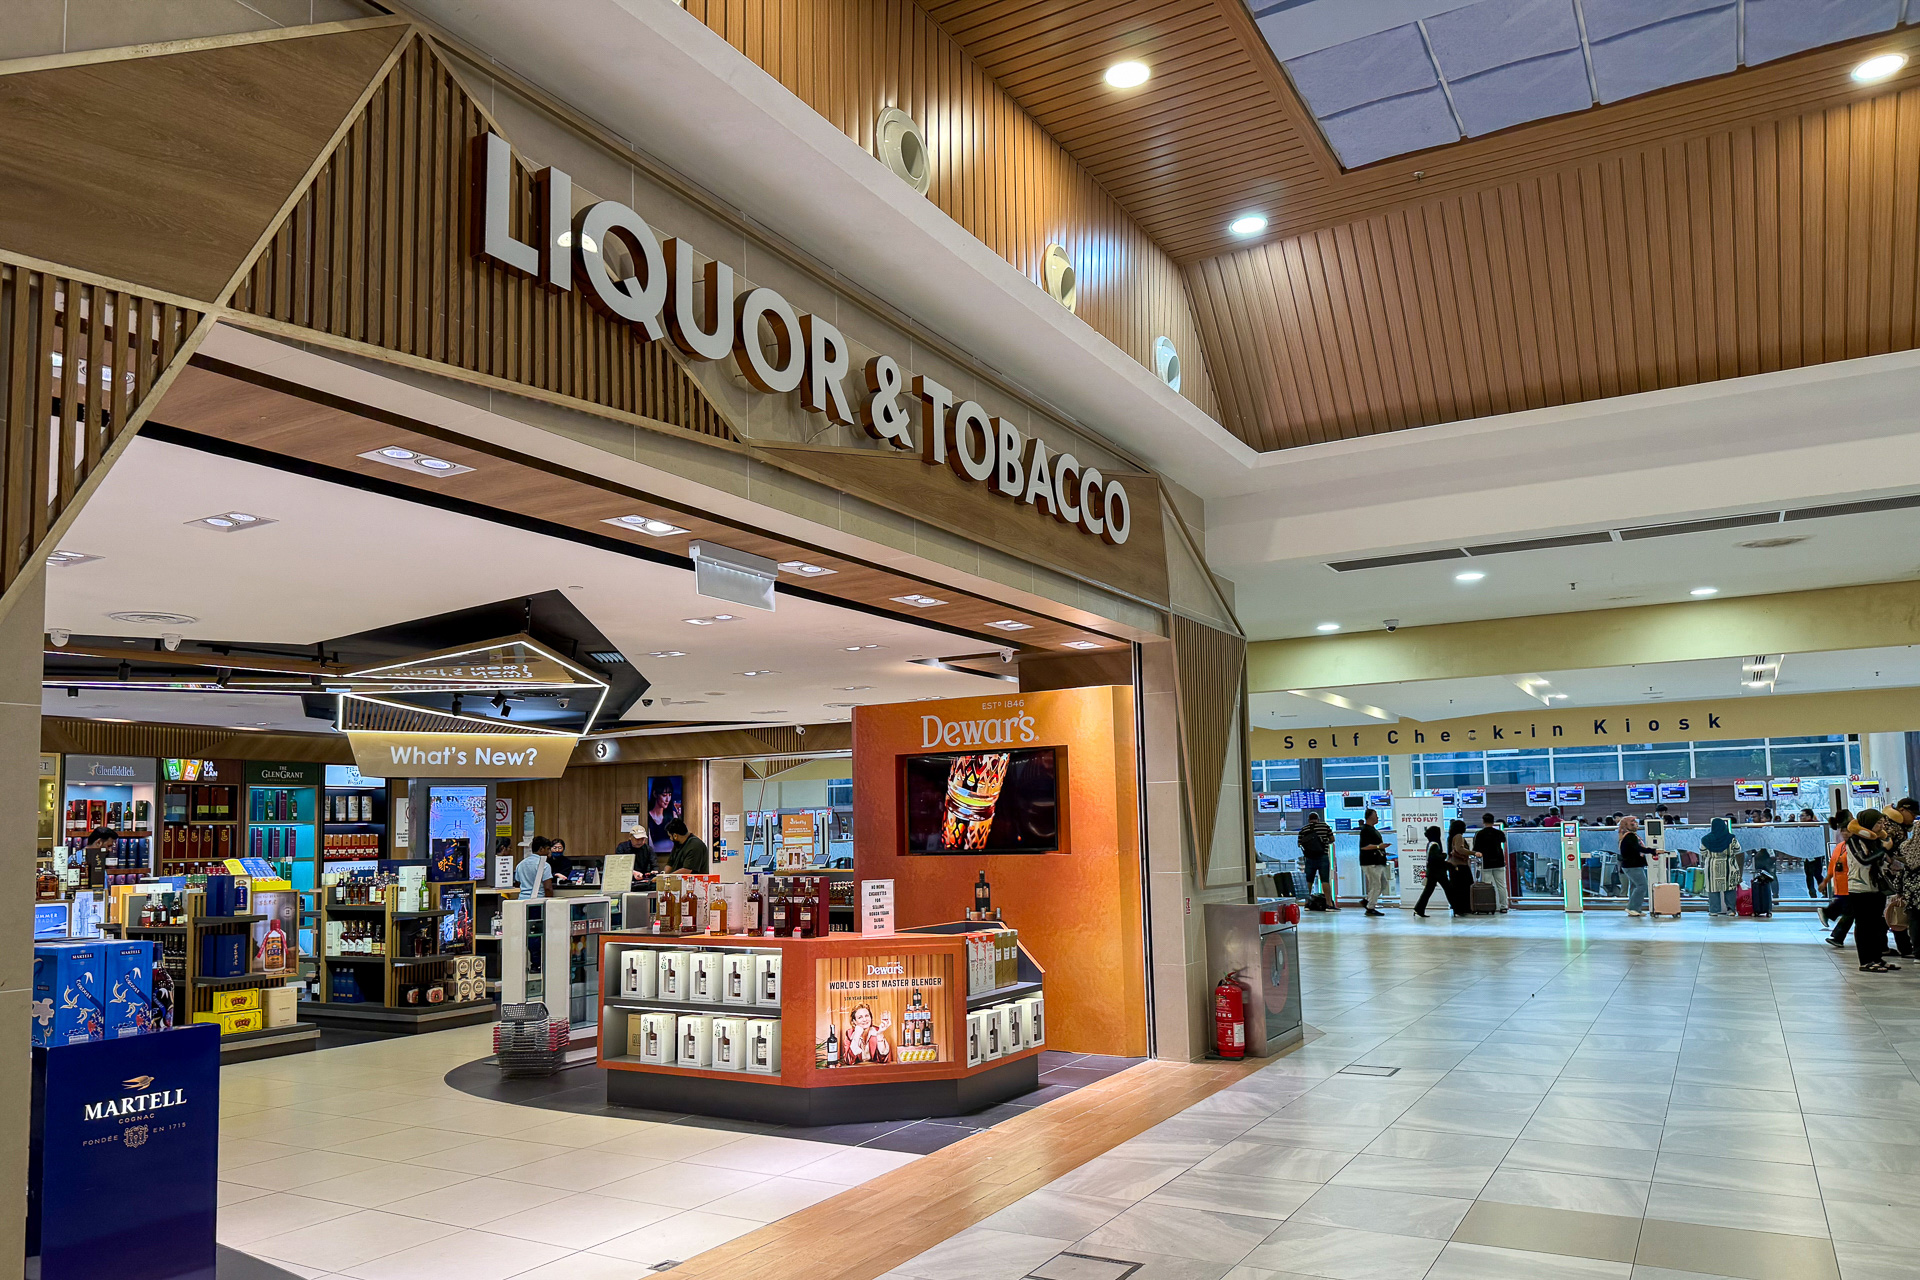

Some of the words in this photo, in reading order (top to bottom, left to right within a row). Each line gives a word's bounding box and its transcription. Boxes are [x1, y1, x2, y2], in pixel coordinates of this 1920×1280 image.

[473, 132, 854, 427] LIQUOR
[862, 355, 914, 450] &
[912, 375, 1131, 546] TOBACCO
[1004, 700, 1025, 708] 1846
[921, 710, 1036, 748] Dewar's
[1284, 732, 1360, 750] Self
[1387, 723, 1563, 744] Check-in
[1594, 713, 1721, 735] Kiosk
[391, 746, 467, 766] What's
[475, 748, 538, 766] New?
[95, 765, 135, 776] Glenfiddich
[867, 964, 904, 976] Dewar's
[829, 980, 860, 990] WORLD'S
[862, 980, 879, 988] BEST
[881, 979, 909, 988] MASTER
[911, 977, 942, 987] BLENDER
[84, 1088, 188, 1121] MARTELL
[118, 1113, 155, 1124] COGNAC
[168, 1122, 186, 1130] 1715
